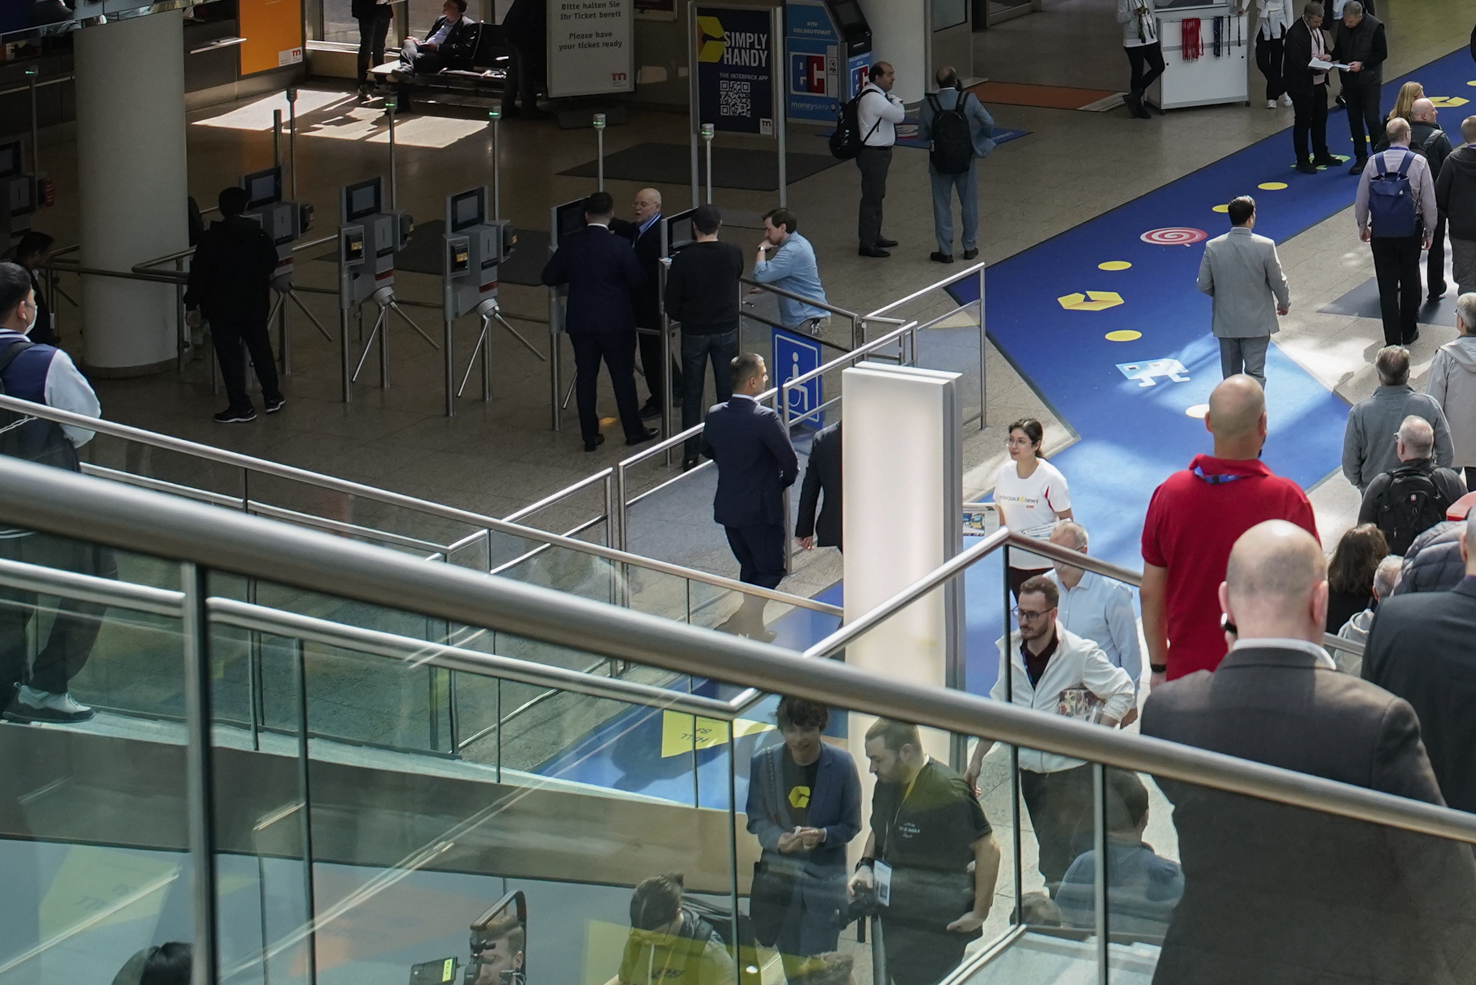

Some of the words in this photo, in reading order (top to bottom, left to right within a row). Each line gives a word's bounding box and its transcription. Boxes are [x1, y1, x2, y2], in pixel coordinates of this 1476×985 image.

[583, 1, 607, 9] halten
[609, 0, 621, 8] Sie
[560, 13, 571, 21] Ihr
[575, 12, 597, 20] Ticket
[600, 10, 622, 19] bereit
[596, 31, 613, 39] have
[559, 42, 575, 51] your
[577, 41, 600, 49] ticket
[602, 40, 623, 50] ready
[723, 31, 768, 50] SIMPLY
[723, 49, 768, 67] HANDY
[731, 73, 758, 81] INTERPACK
[791, 102, 829, 110] moneyserv
